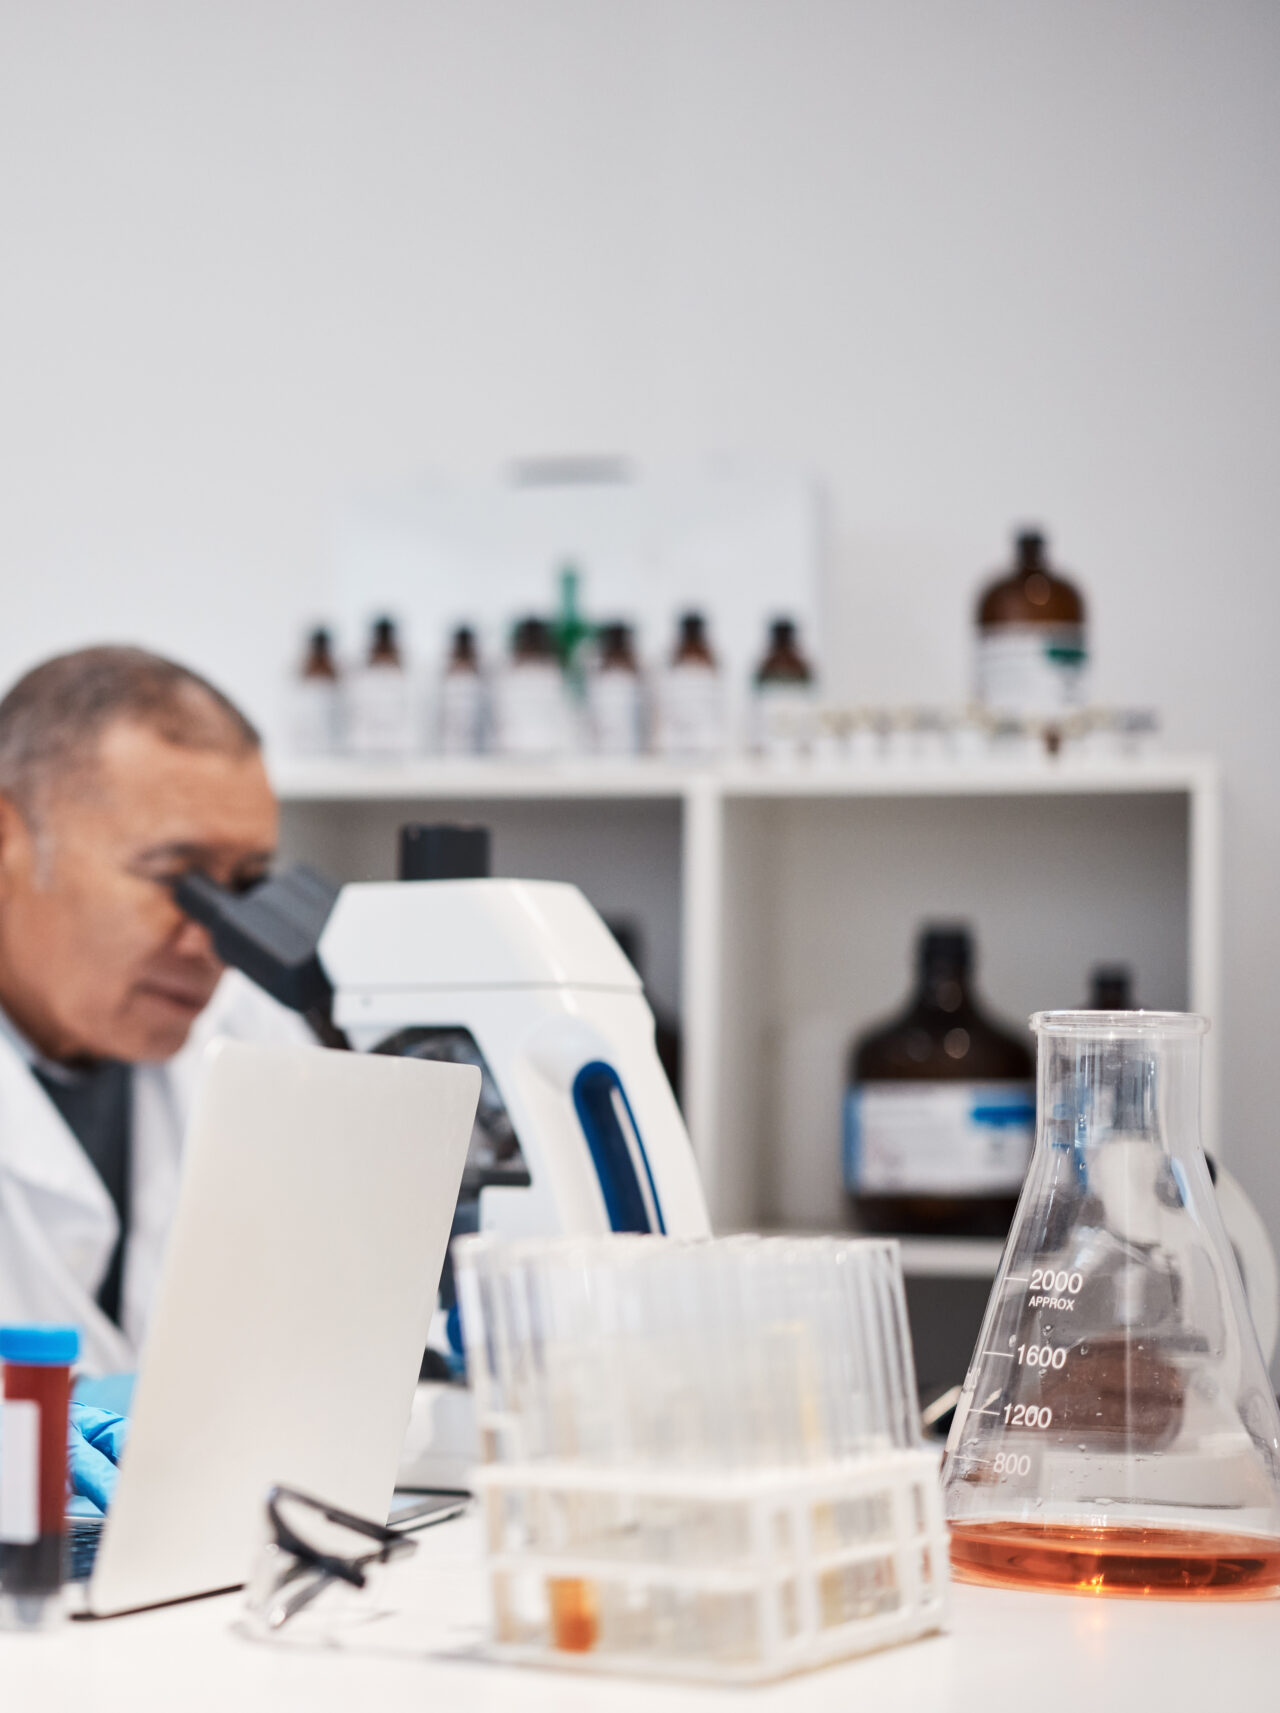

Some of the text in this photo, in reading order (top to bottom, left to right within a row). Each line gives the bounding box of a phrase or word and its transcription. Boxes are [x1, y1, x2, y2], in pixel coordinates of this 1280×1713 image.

[1029, 1269, 1083, 1293] 2000
[1028, 1295, 1075, 1311] APPROX
[1017, 1344, 1066, 1369] 1600
[1003, 1403, 1052, 1428] 1200
[993, 1453, 1031, 1476] 800
